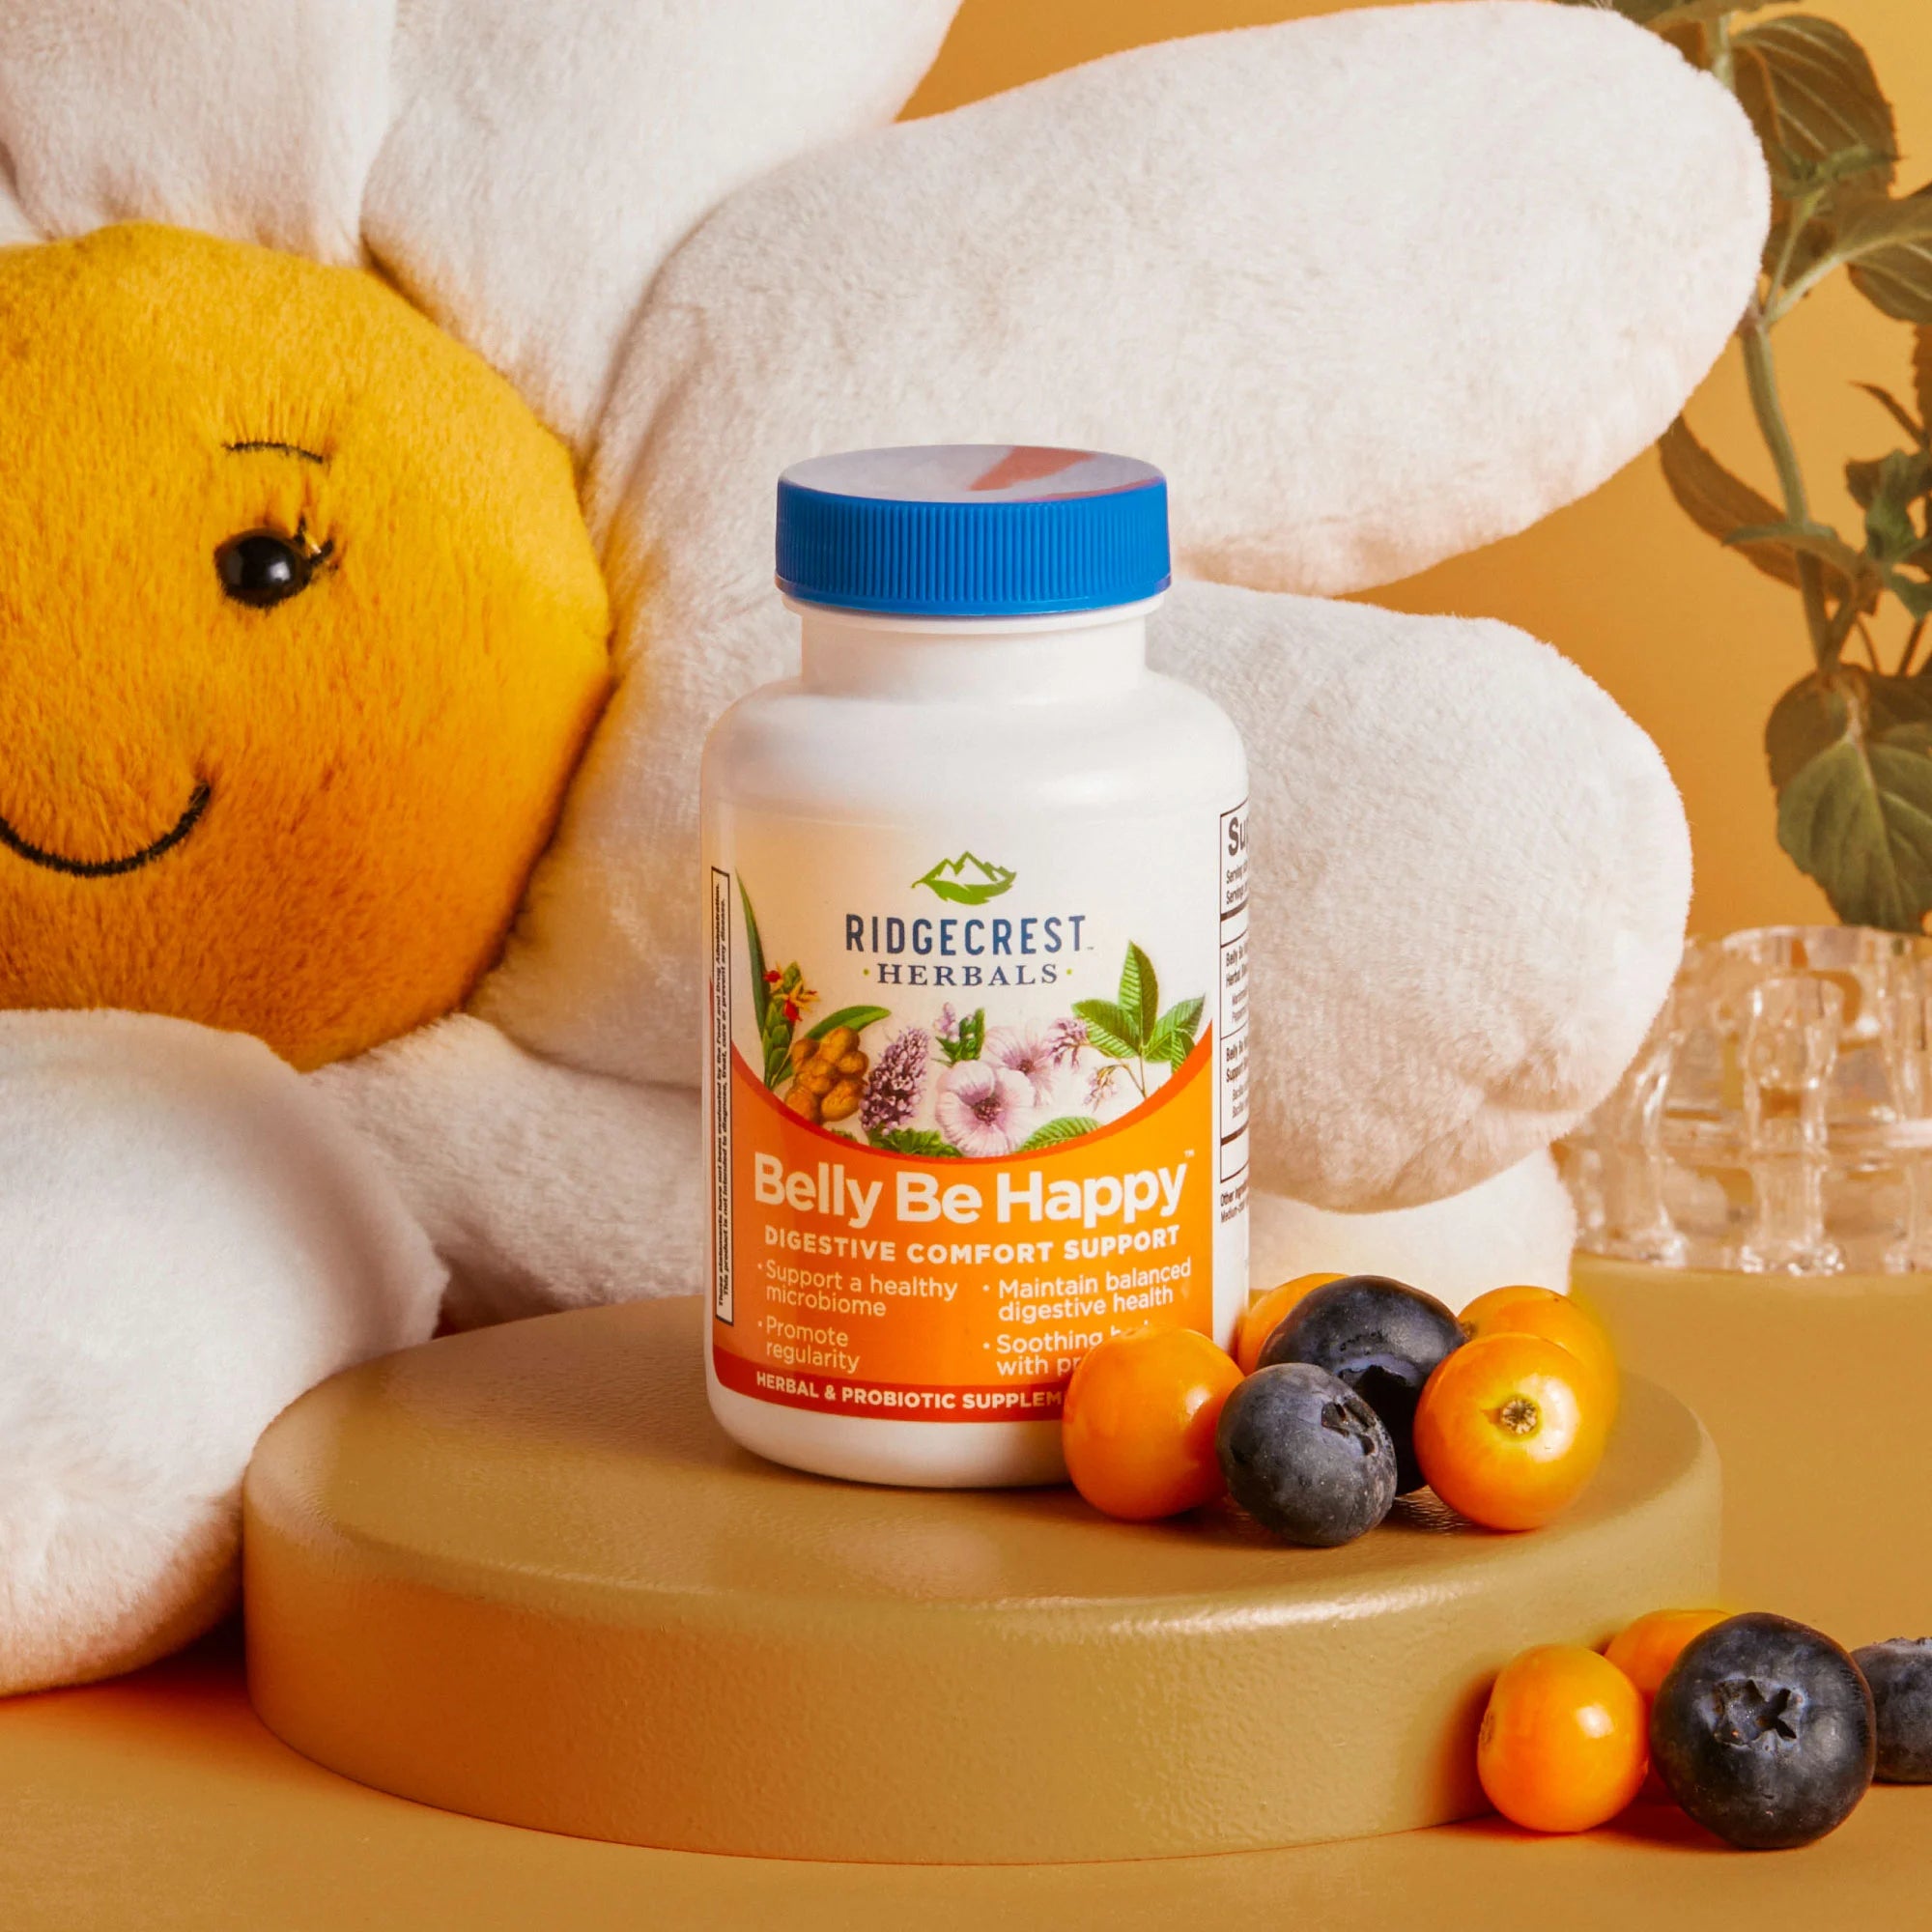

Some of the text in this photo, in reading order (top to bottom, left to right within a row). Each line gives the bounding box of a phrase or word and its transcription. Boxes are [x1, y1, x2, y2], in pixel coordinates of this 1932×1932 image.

[845, 913, 1086, 956] RIDGECREST
[876, 963, 1058, 986] HERBALS
[753, 1151, 884, 1230] Belly
[895, 1171, 982, 1224] Be
[764, 1224, 1180, 1265] DIGESTIVE COMFORT SUPPORT
[766, 1259, 958, 1302] Support a healthy
[999, 1257, 1192, 1299] Maintain balanced
[766, 1284, 887, 1318] microbiome
[998, 1284, 1174, 1325] digestive health
[766, 1315, 849, 1348] Promote
[766, 1340, 861, 1375] regularity
[997, 1354, 1049, 1377] with
[755, 1371, 1062, 1410] HERBAL & PROBIOTIC SUPPLEM
